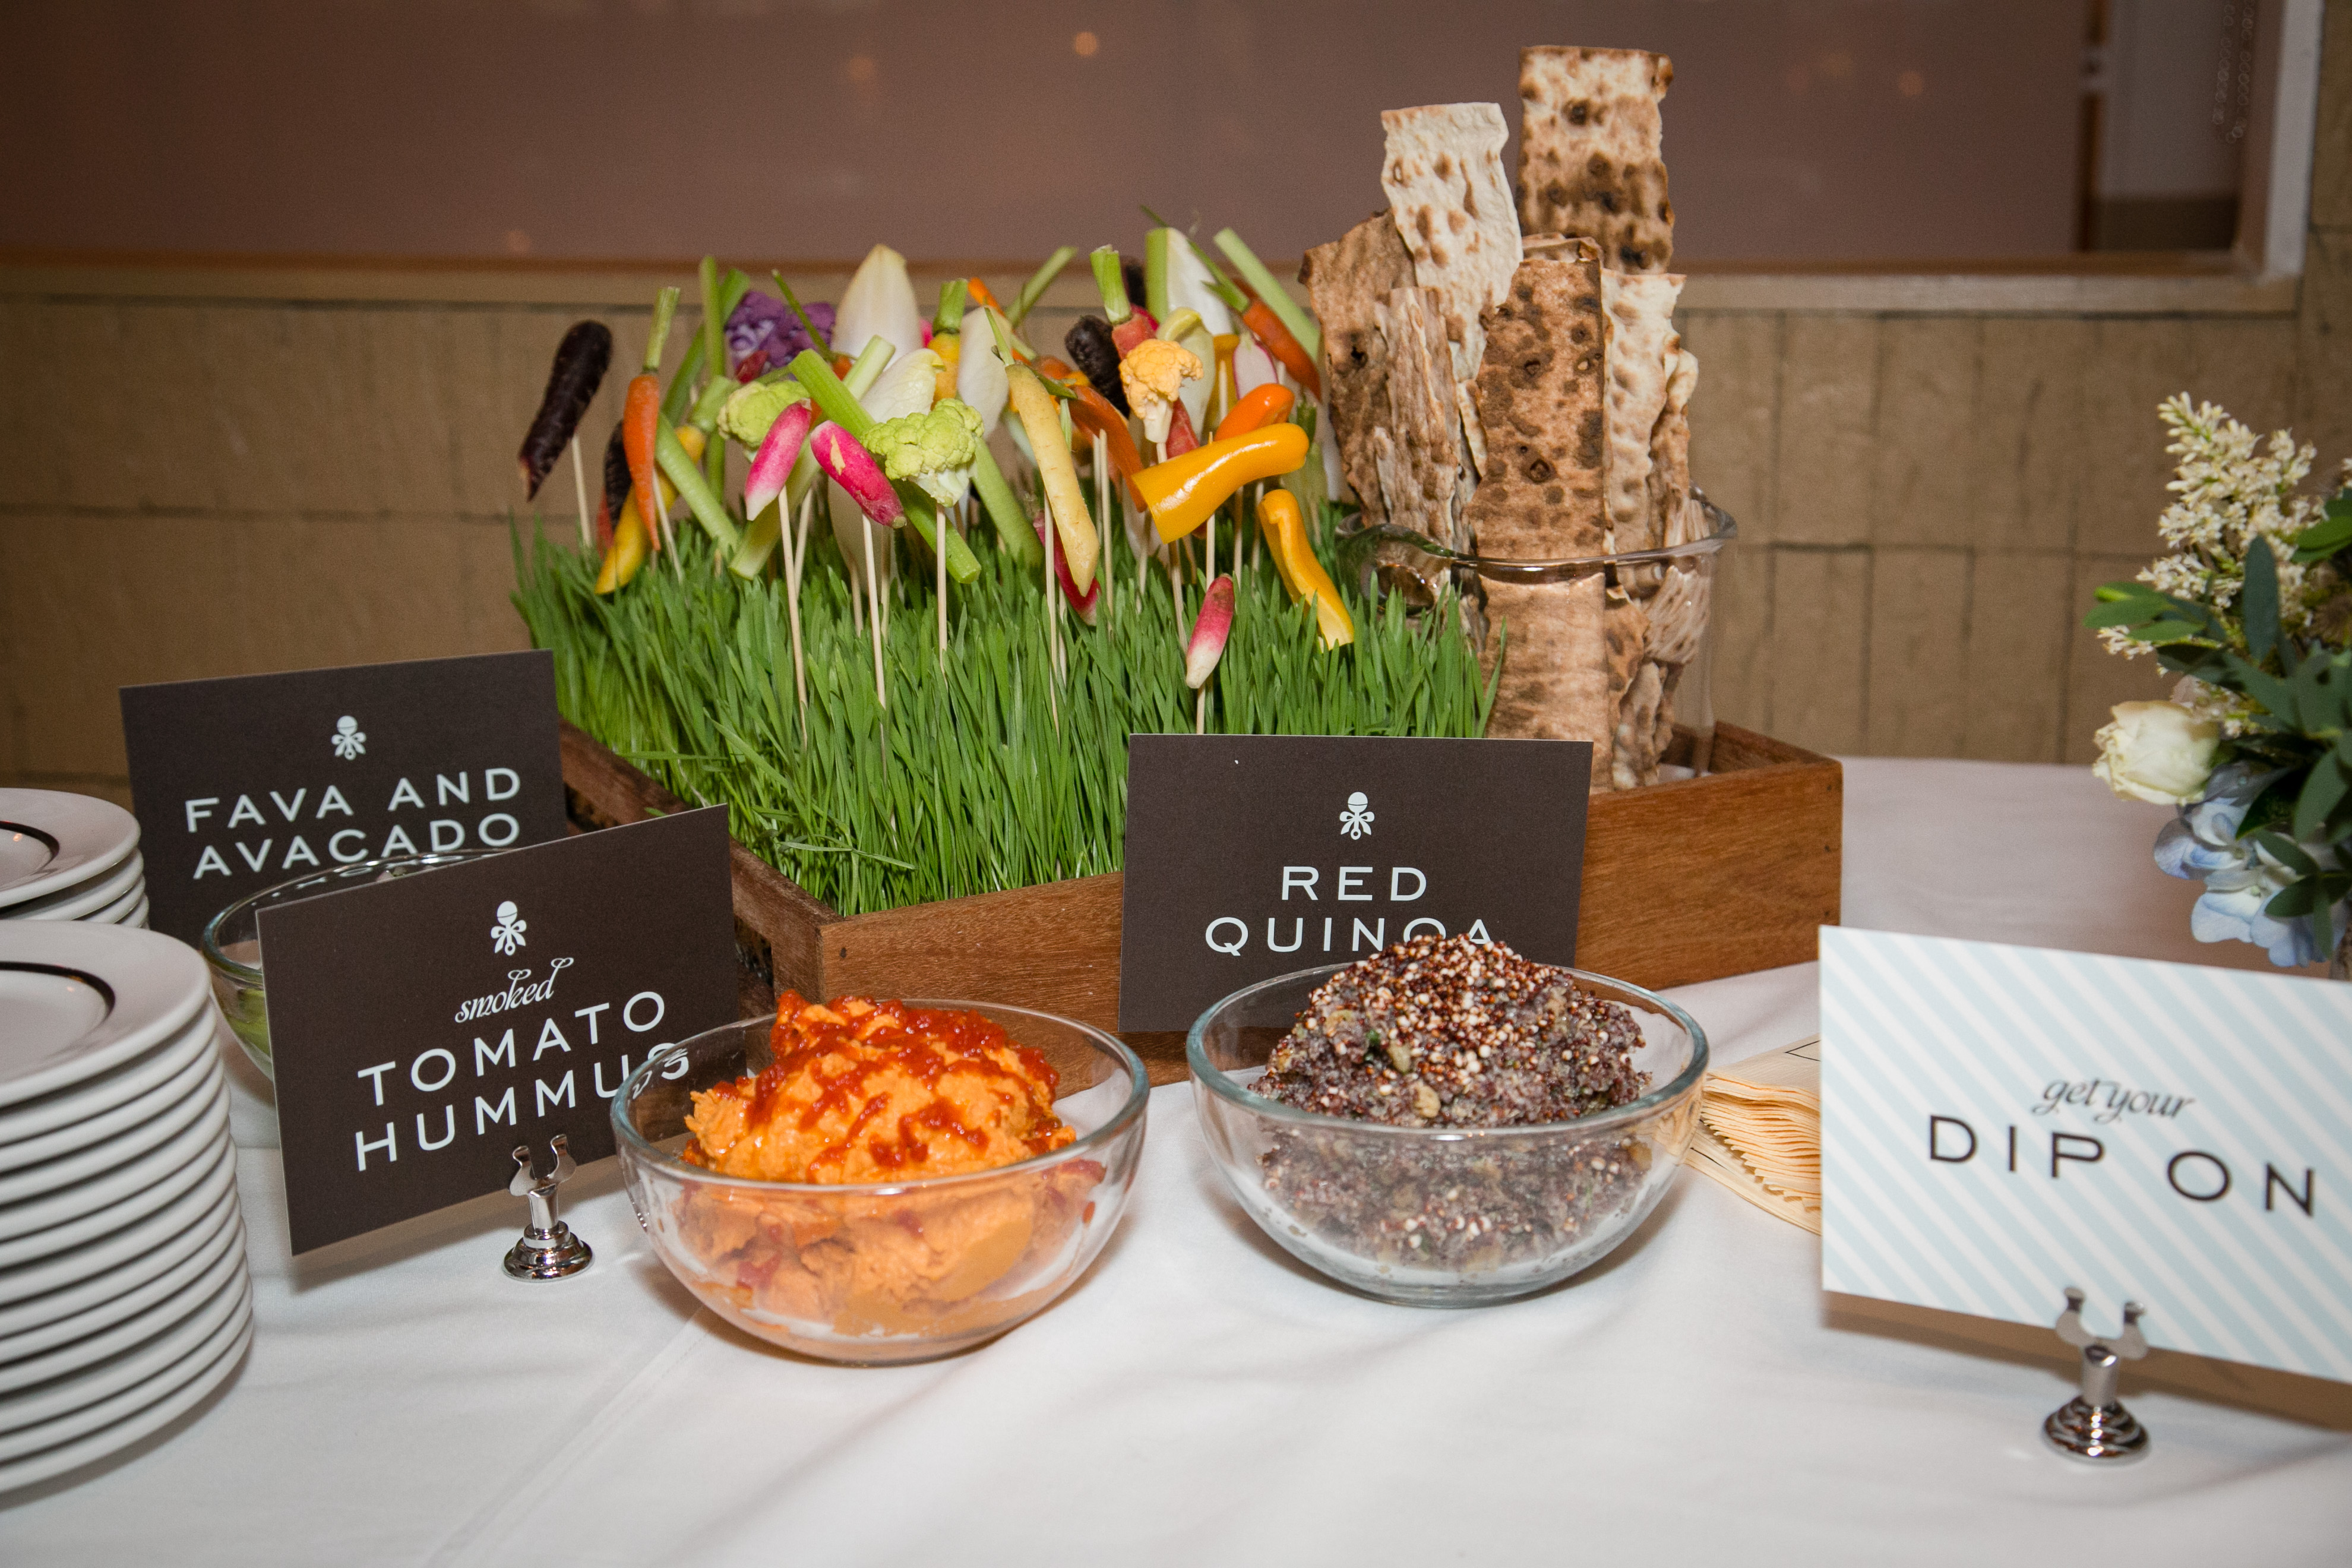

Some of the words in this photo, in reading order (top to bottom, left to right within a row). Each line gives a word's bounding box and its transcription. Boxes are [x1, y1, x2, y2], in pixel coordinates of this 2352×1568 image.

[185, 785, 353, 833] FAVA
[387, 767, 521, 811] AND
[192, 813, 520, 880] AVACADO
[1281, 865, 1427, 902] RED
[454, 957, 574, 1023] smoked
[358, 991, 665, 1106] TOMATO
[355, 1042, 690, 1172] HUMMUS
[2031, 1079, 2099, 1115] get
[2093, 1079, 2196, 1124] your
[1929, 1114, 2106, 1179] DIP
[2167, 1150, 2315, 1218] ON
